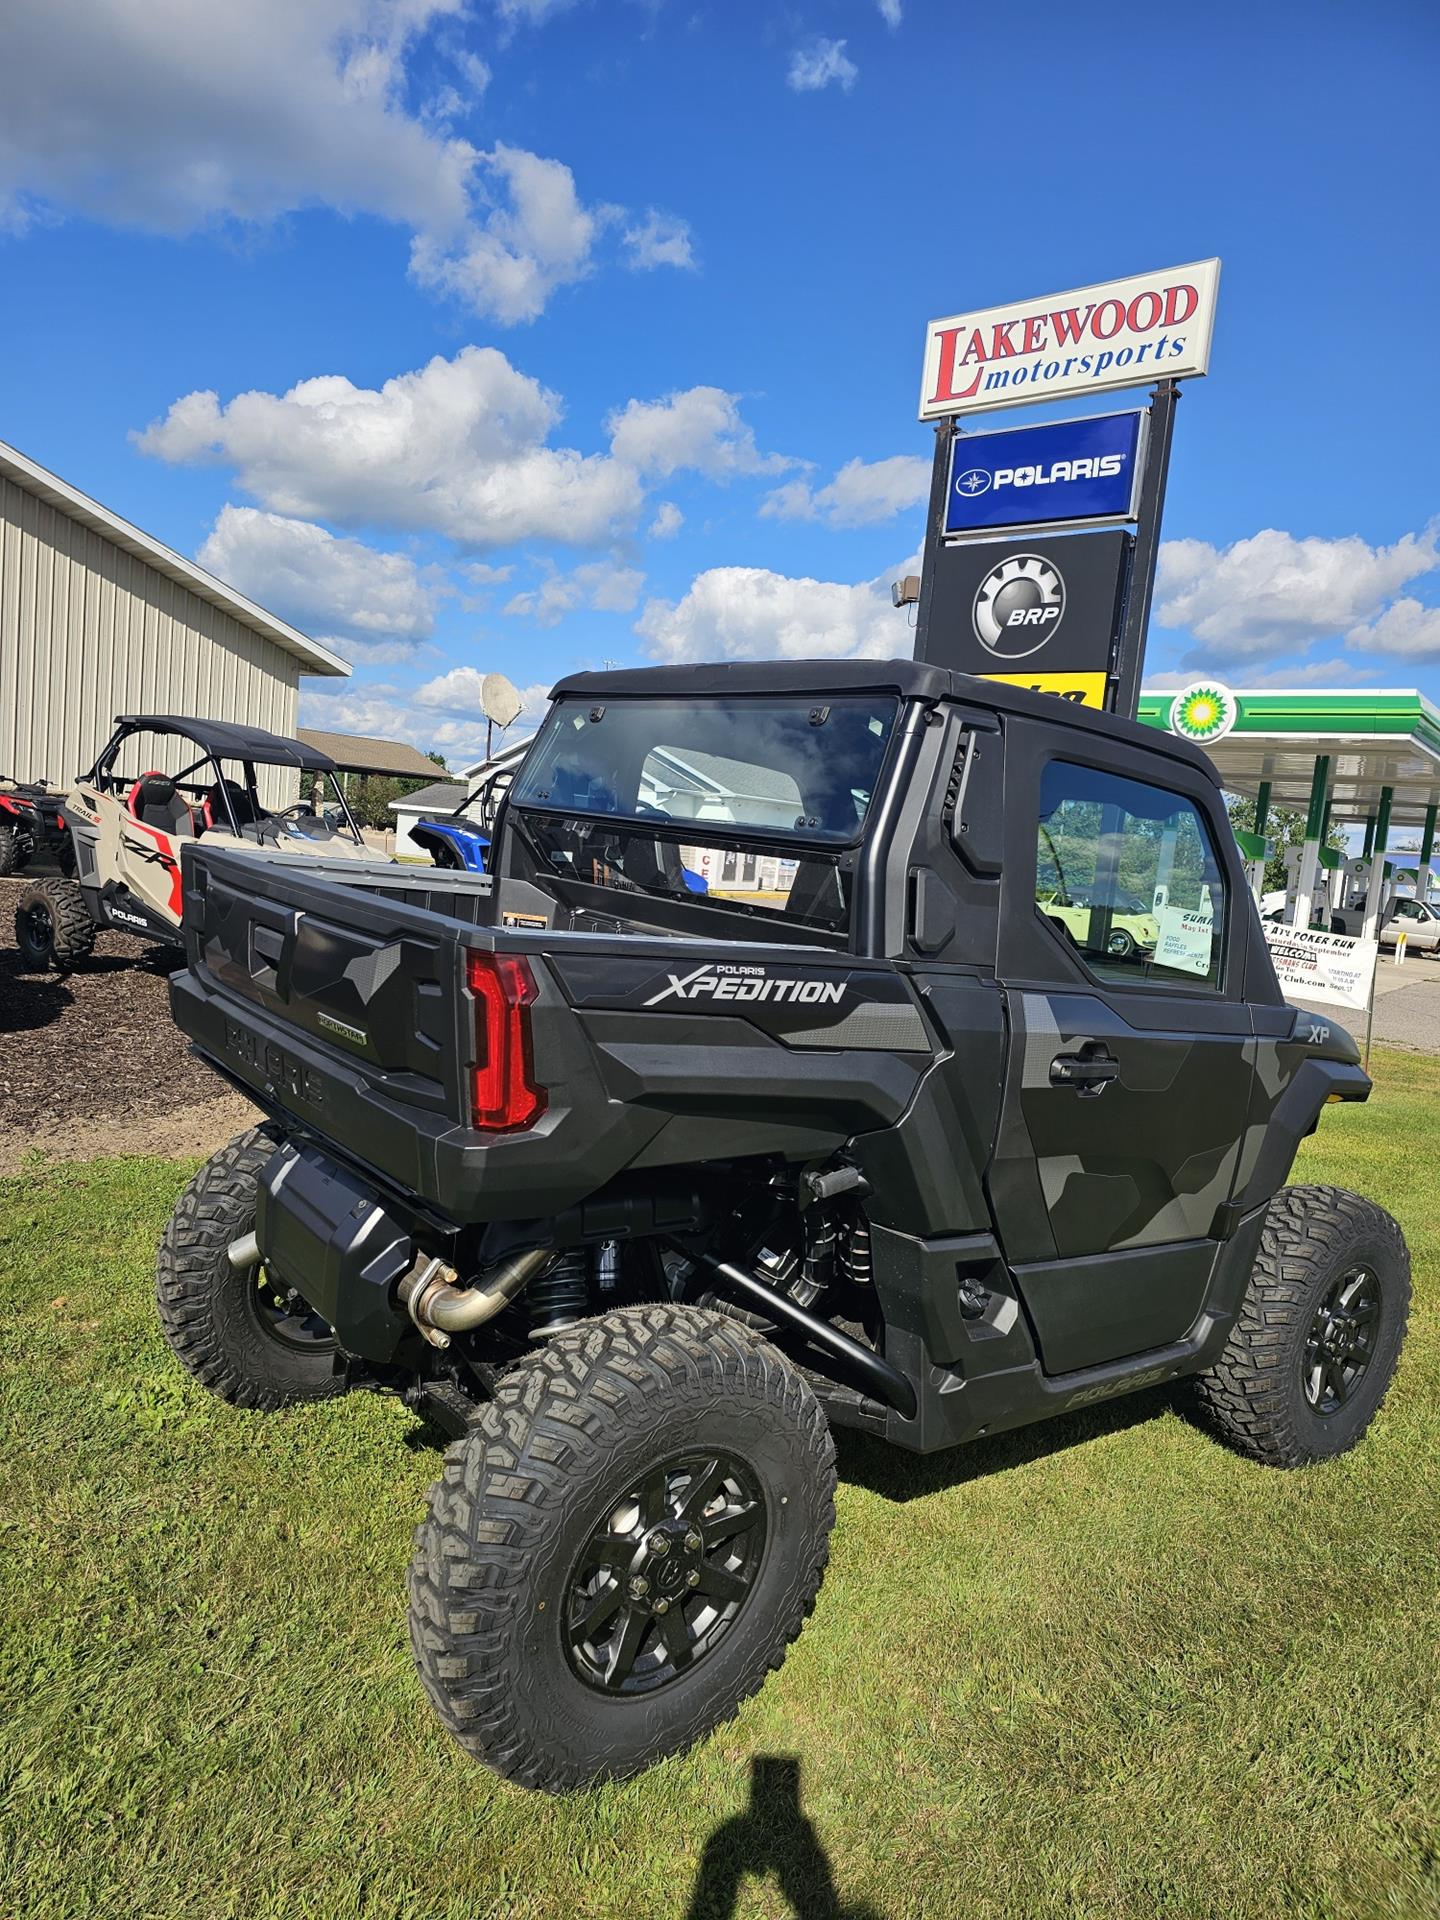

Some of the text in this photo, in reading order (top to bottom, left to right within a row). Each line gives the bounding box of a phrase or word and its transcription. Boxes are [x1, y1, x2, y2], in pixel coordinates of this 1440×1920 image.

[927, 284, 1199, 404] LAKEWOOD
[984, 335, 1187, 391] motorsports
[993, 454, 1121, 490] POLARIS
[1006, 607, 1060, 627] BRP
[72, 804, 102, 824] TRAIL S
[112, 908, 148, 927] POLARIS
[1182, 923, 1196, 932] May
[1164, 941, 1187, 950] RAFFLES
[1270, 926, 1291, 937] ATV
[1294, 931, 1330, 945] POKER
[1332, 939, 1356, 949] RUN
[1270, 945, 1317, 961] WELCOME
[1308, 944, 1351, 957] September
[716, 964, 766, 976] POLARIS
[1301, 961, 1318, 971] CLUB
[641, 964, 848, 1006] XPEDITION
[1307, 1025, 1330, 1045] XP
[224, 1016, 328, 1112] POLARIS
[1065, 1367, 1166, 1408] POLARIS
